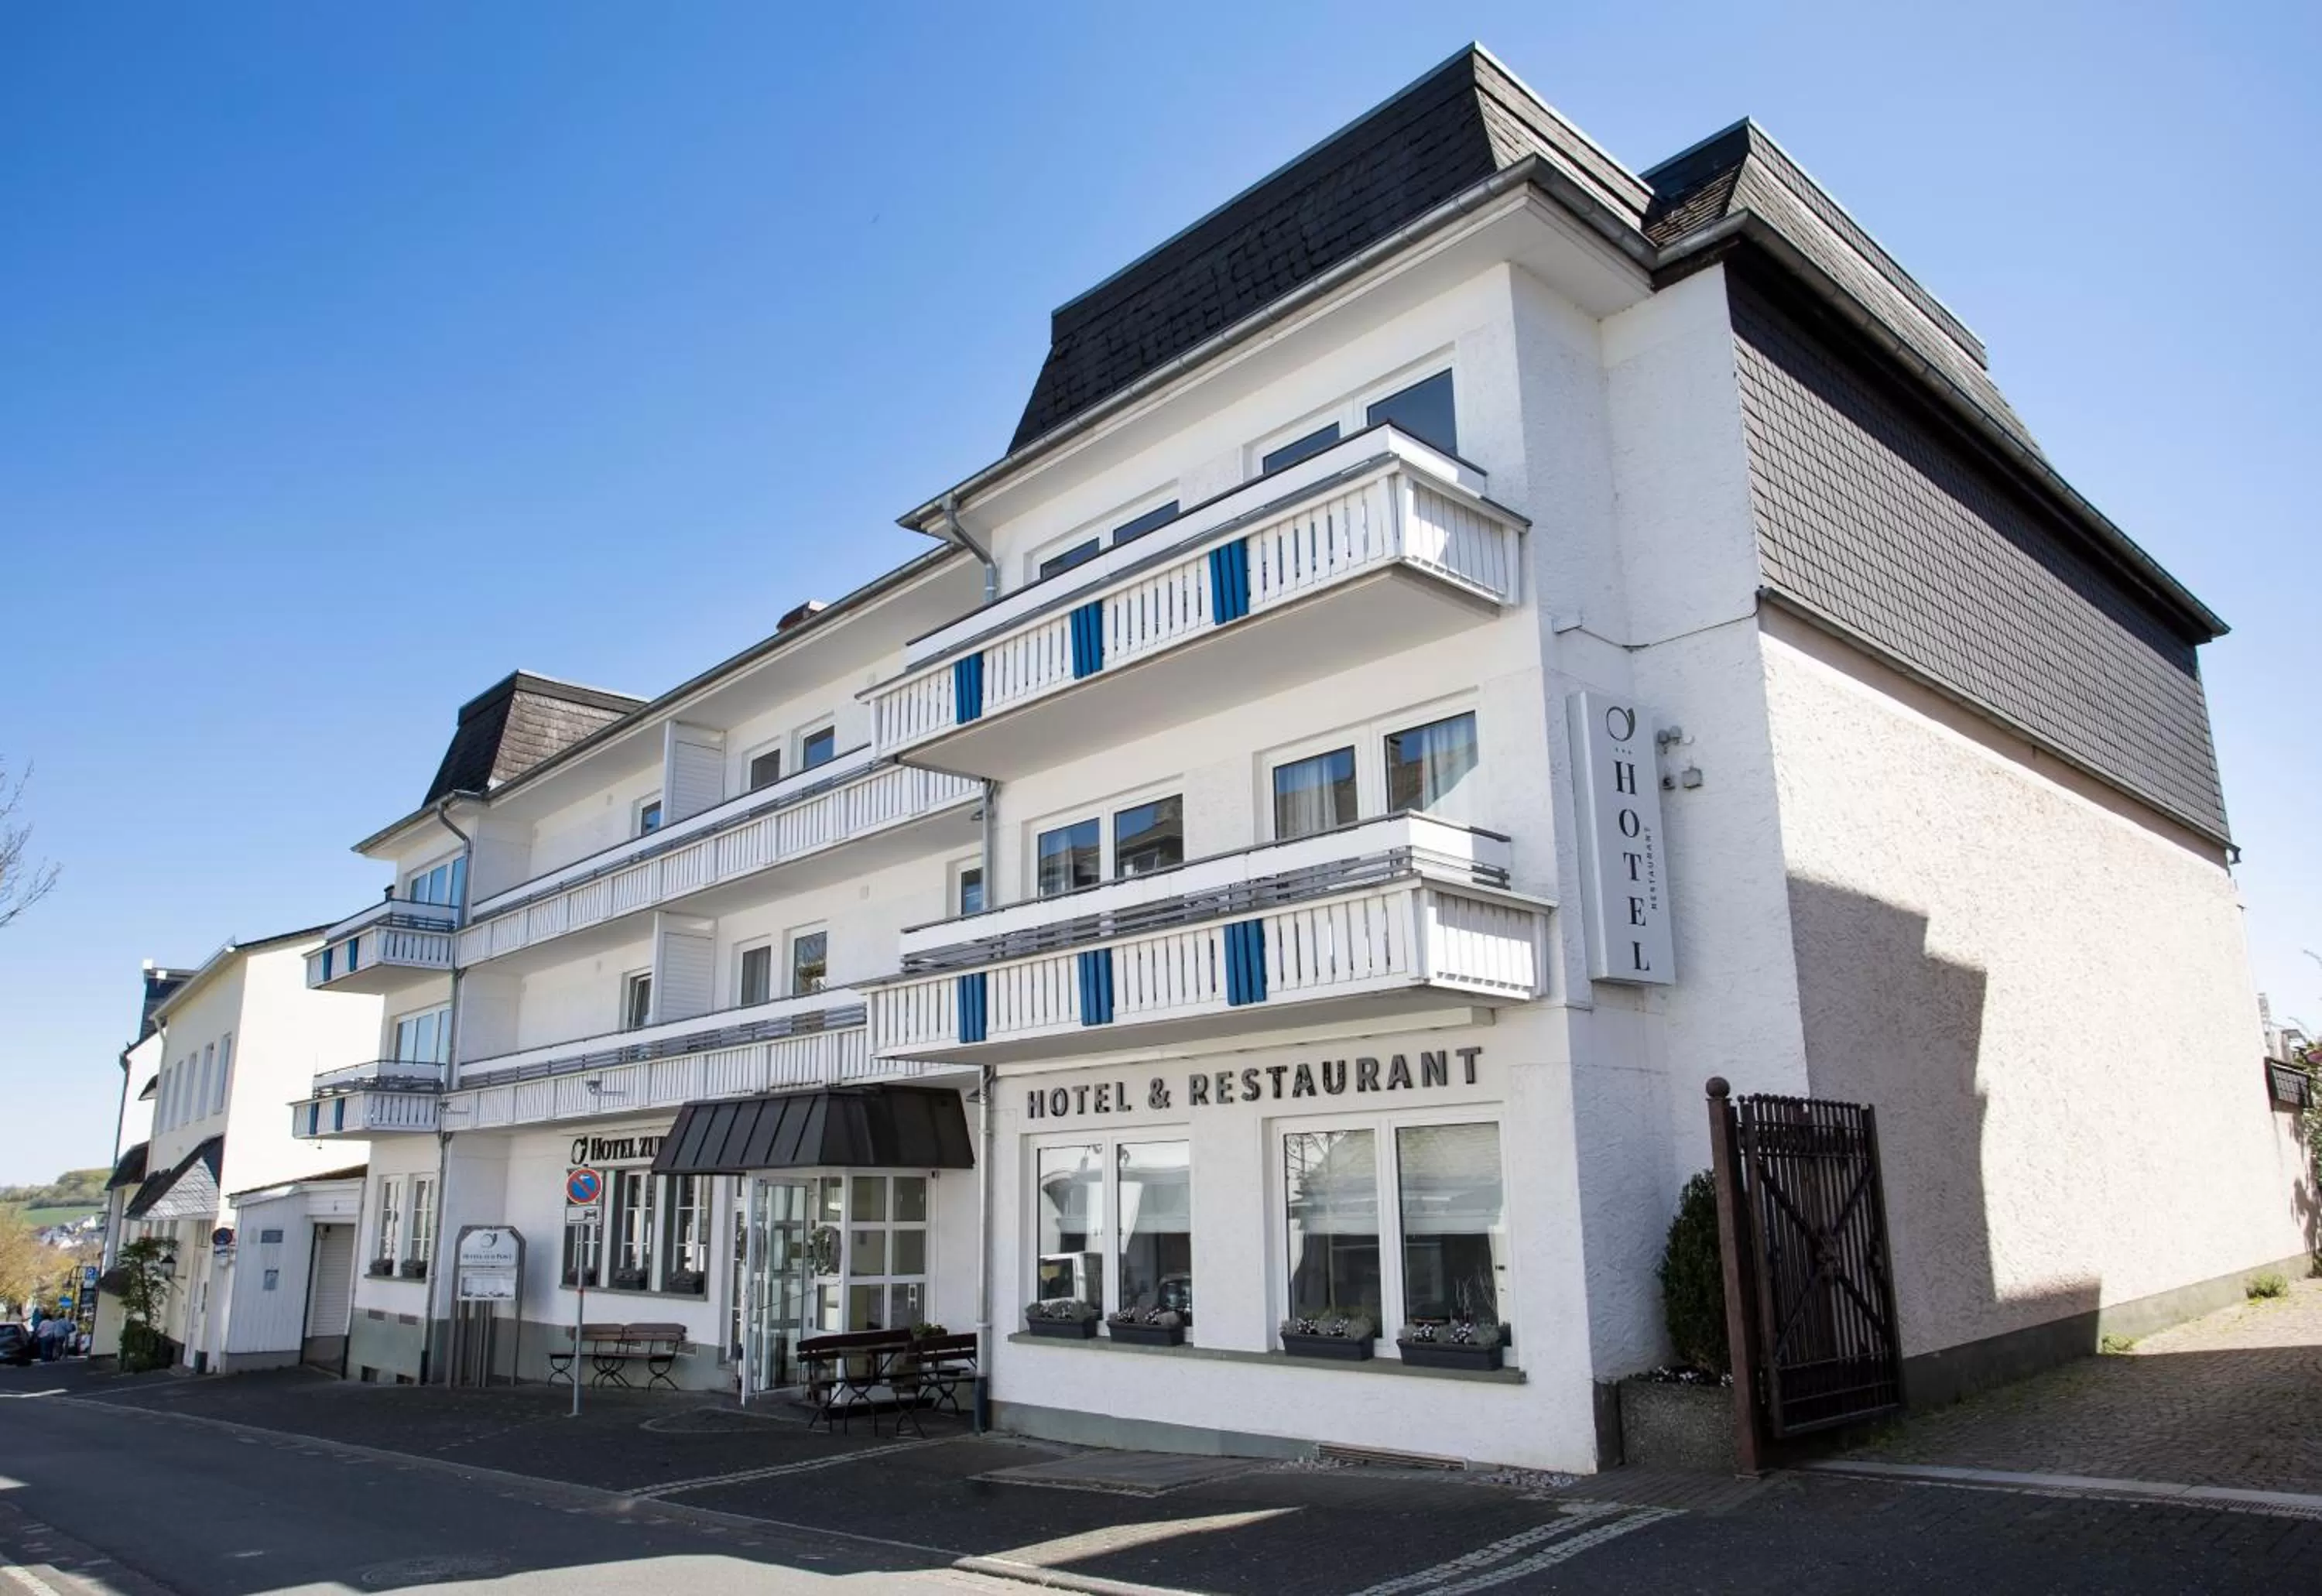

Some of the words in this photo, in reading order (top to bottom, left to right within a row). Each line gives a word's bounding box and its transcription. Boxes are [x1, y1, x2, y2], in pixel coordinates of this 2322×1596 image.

[1614, 759, 1650, 971] HOTEL
[1643, 826, 1657, 909] RESTAURANT
[1027, 1081, 1132, 1119] HOTEL
[1148, 1077, 1171, 1109] &
[1188, 1046, 1482, 1106] RESTAURANT
[590, 1137, 637, 1160] HOTEL
